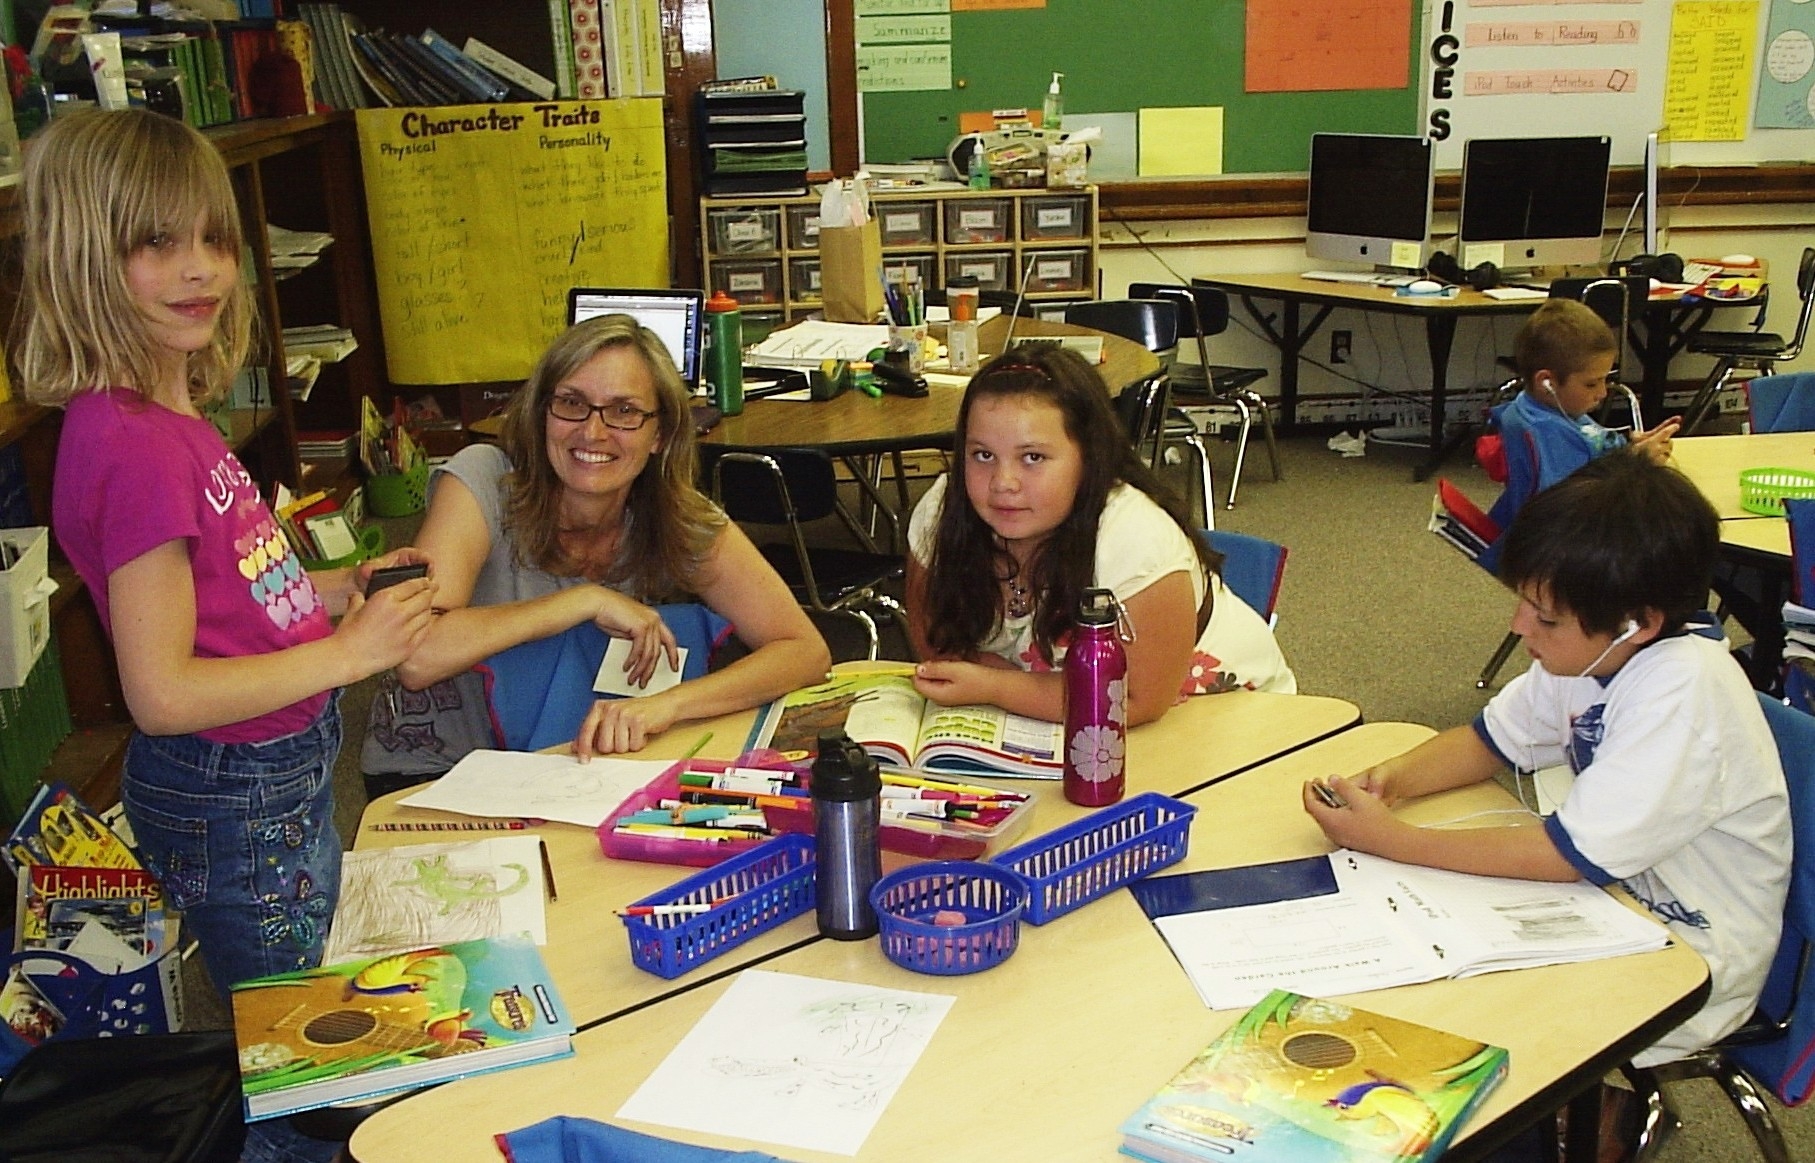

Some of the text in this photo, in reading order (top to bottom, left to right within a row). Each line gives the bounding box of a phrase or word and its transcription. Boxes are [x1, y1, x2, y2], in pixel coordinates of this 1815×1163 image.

[873, 23, 946, 37] Summarize
[1690, 15, 1726, 29] SAID
[1488, 25, 1598, 43] Listen to Reading
[1429, 0, 1460, 142] ICES
[1474, 74, 1595, 90] iPod Touch Activities
[401, 104, 601, 139] Character Traits
[380, 139, 437, 161] Physical
[539, 131, 611, 152] Personality
[32, 873, 161, 901] Highlights
